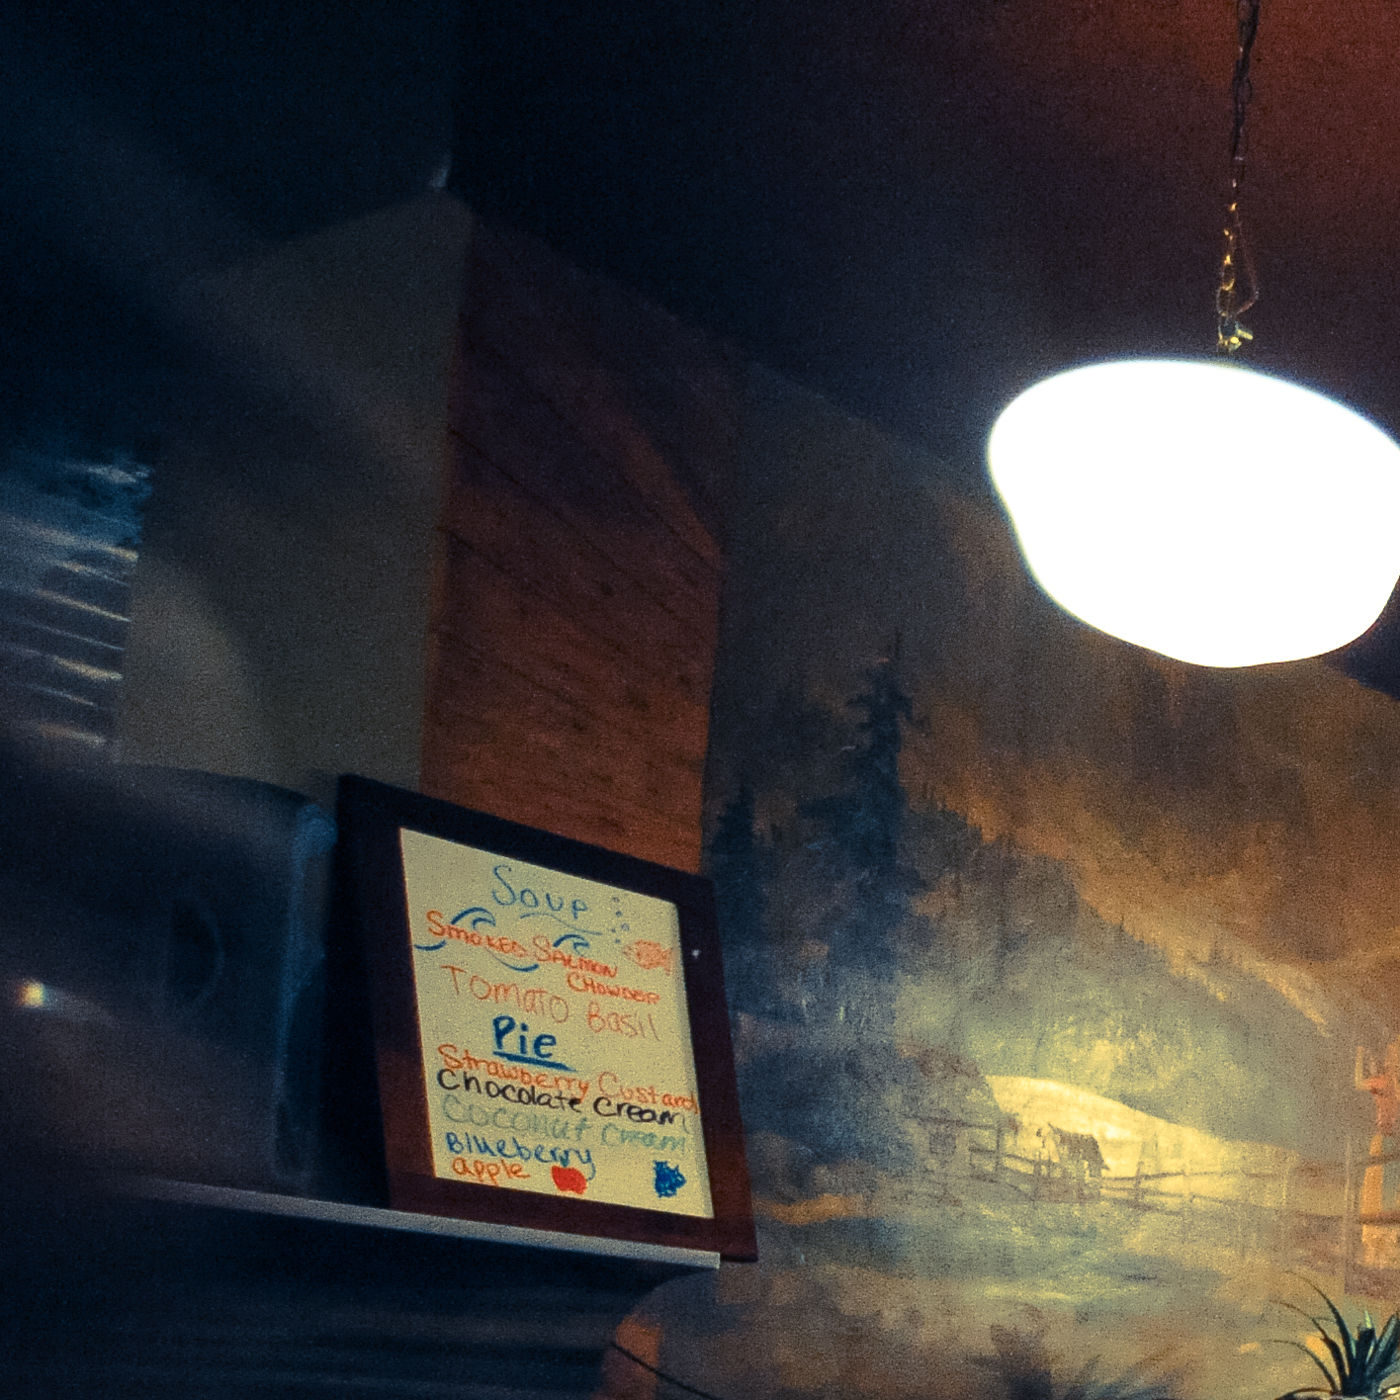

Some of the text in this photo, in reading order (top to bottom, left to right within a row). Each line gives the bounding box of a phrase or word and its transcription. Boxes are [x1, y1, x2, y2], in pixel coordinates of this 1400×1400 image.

[492, 864, 588, 920] Soup
[493, 1014, 557, 1058] Pie
[436, 1067, 691, 1135] Chocolate Cream
[437, 1043, 700, 1115] Strawberry Custard
[442, 1094, 593, 1141] Coconut
[445, 1131, 597, 1182] Blueberry
[452, 1156, 531, 1187] apple
